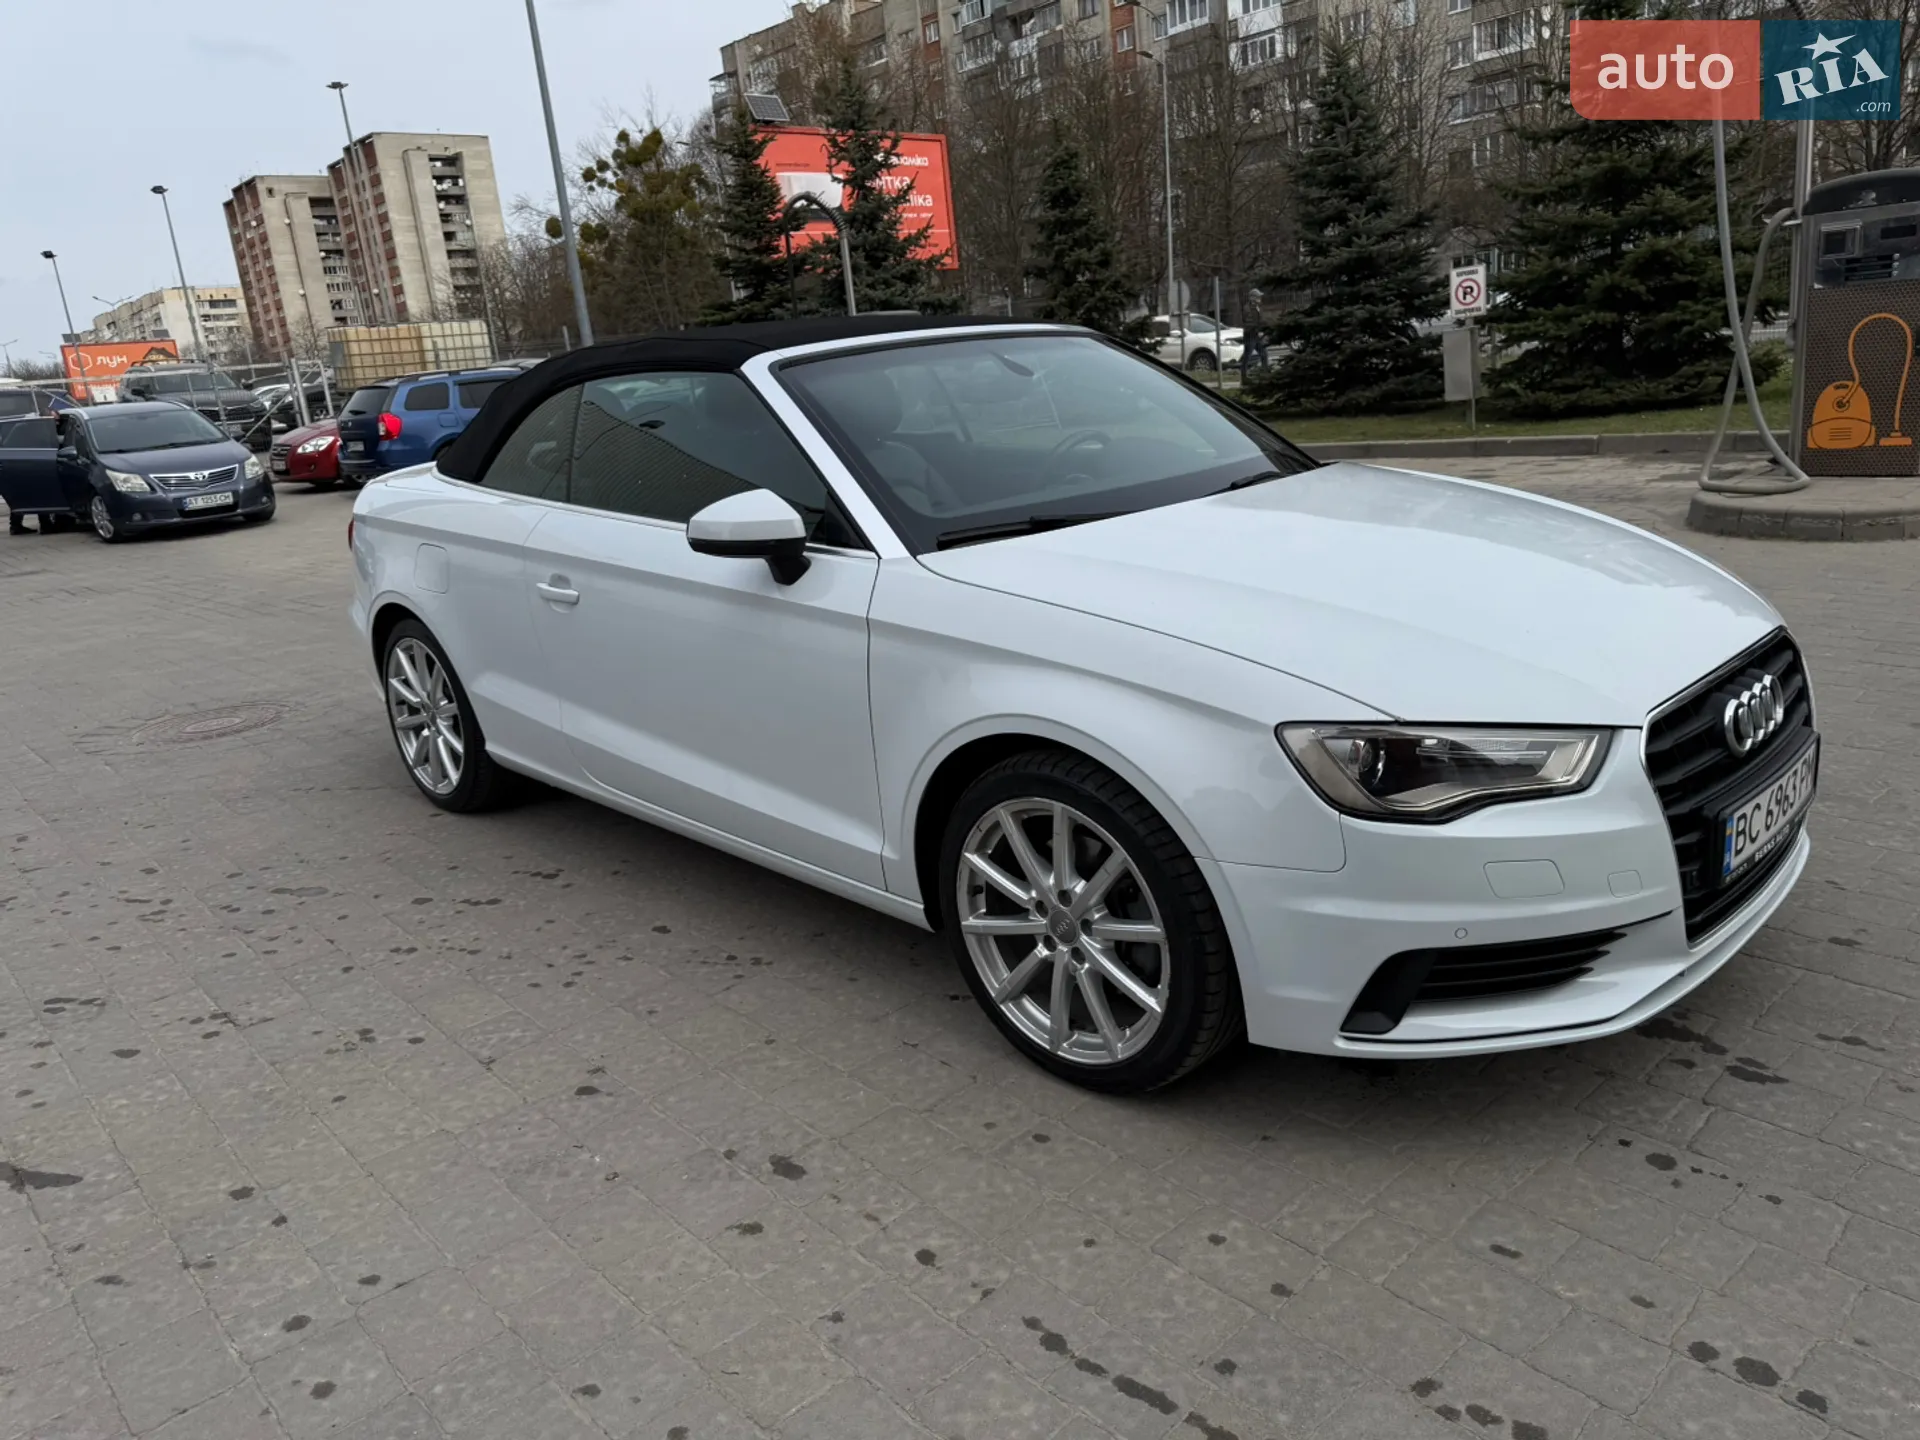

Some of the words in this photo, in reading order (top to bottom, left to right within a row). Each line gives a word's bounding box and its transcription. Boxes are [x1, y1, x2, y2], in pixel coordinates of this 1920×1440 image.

[96, 355, 128, 368] лун
[1735, 802, 1761, 858] BC
[1764, 766, 1799, 832] 6963
